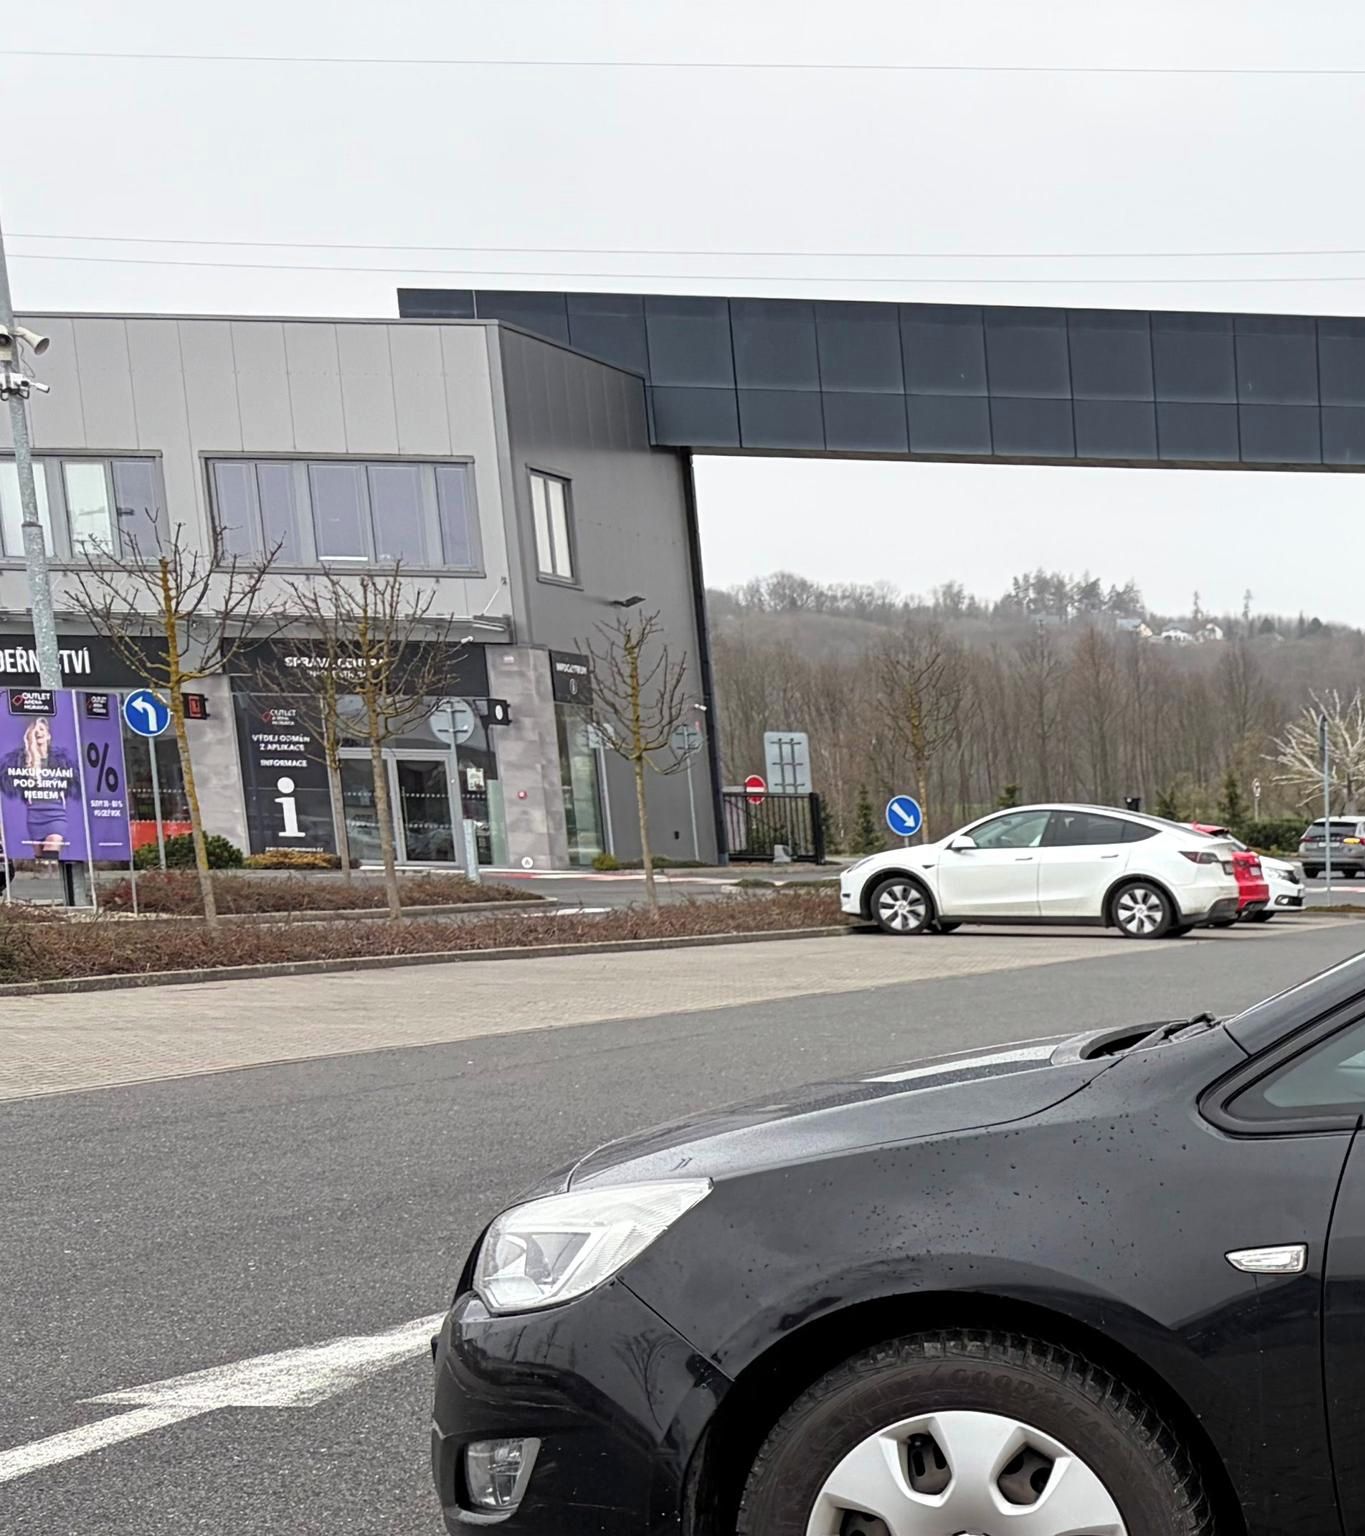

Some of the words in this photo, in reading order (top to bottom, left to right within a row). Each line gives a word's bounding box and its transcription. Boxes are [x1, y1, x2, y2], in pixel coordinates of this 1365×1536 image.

[0, 646, 91, 674] EŘNTVÍ
[22, 692, 51, 700] OUTLET
[260, 759, 308, 767] INFORMACE
[8, 767, 73, 778] NAKUPOVÁNÍ
[13, 779, 34, 788] POD
